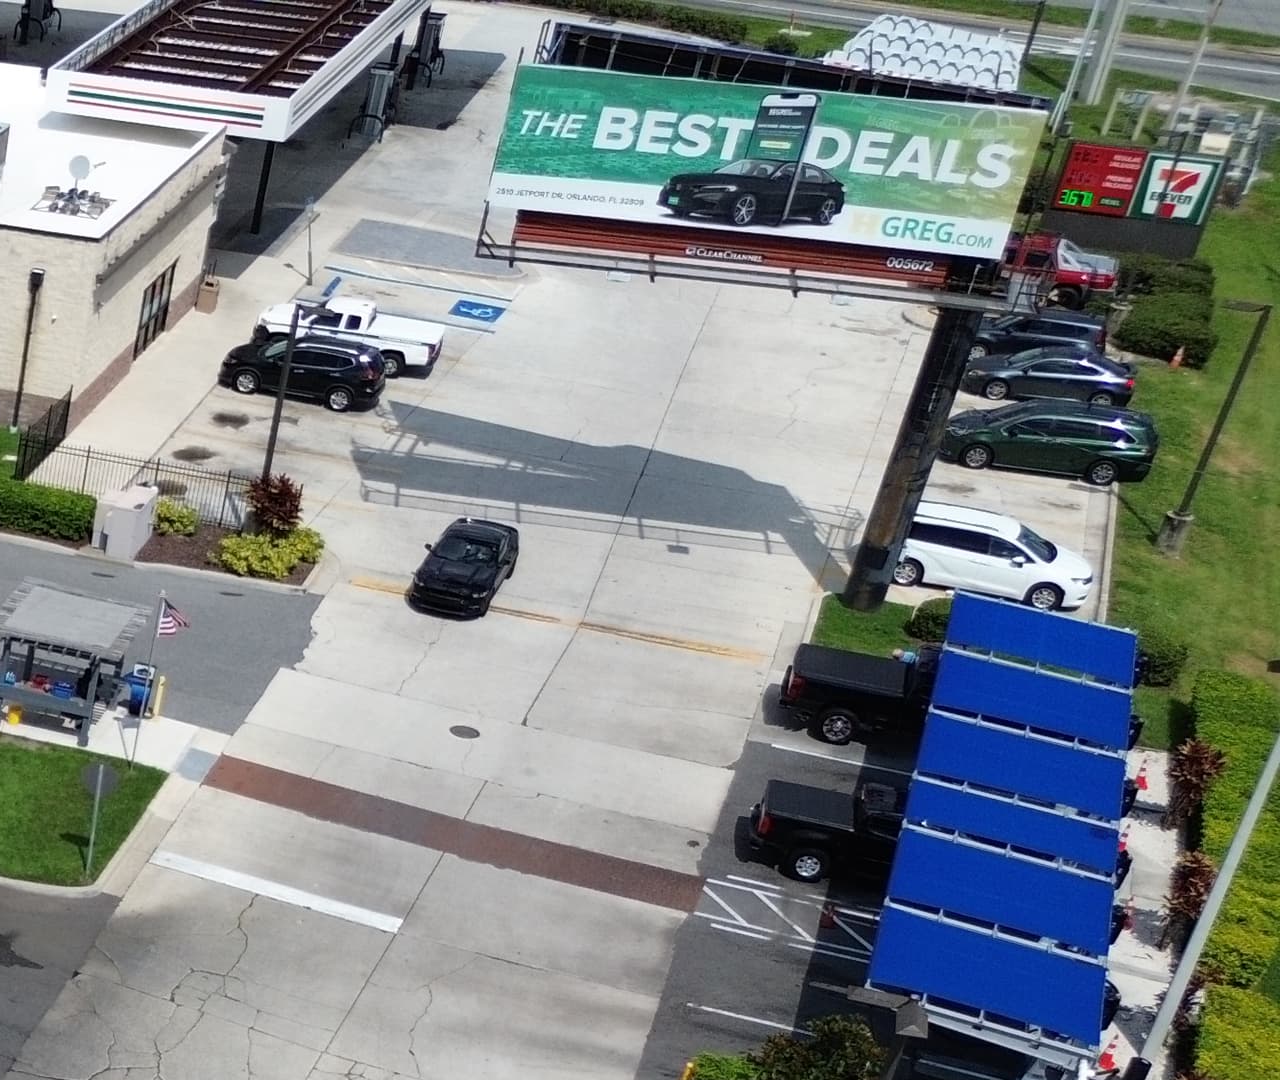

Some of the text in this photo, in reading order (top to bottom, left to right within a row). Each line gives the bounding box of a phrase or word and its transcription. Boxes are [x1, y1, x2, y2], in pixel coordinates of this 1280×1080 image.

[519, 110, 587, 139] THE
[592, 106, 756, 161] BEST
[803, 126, 1017, 189] DEALS
[886, 256, 934, 272] 005672
